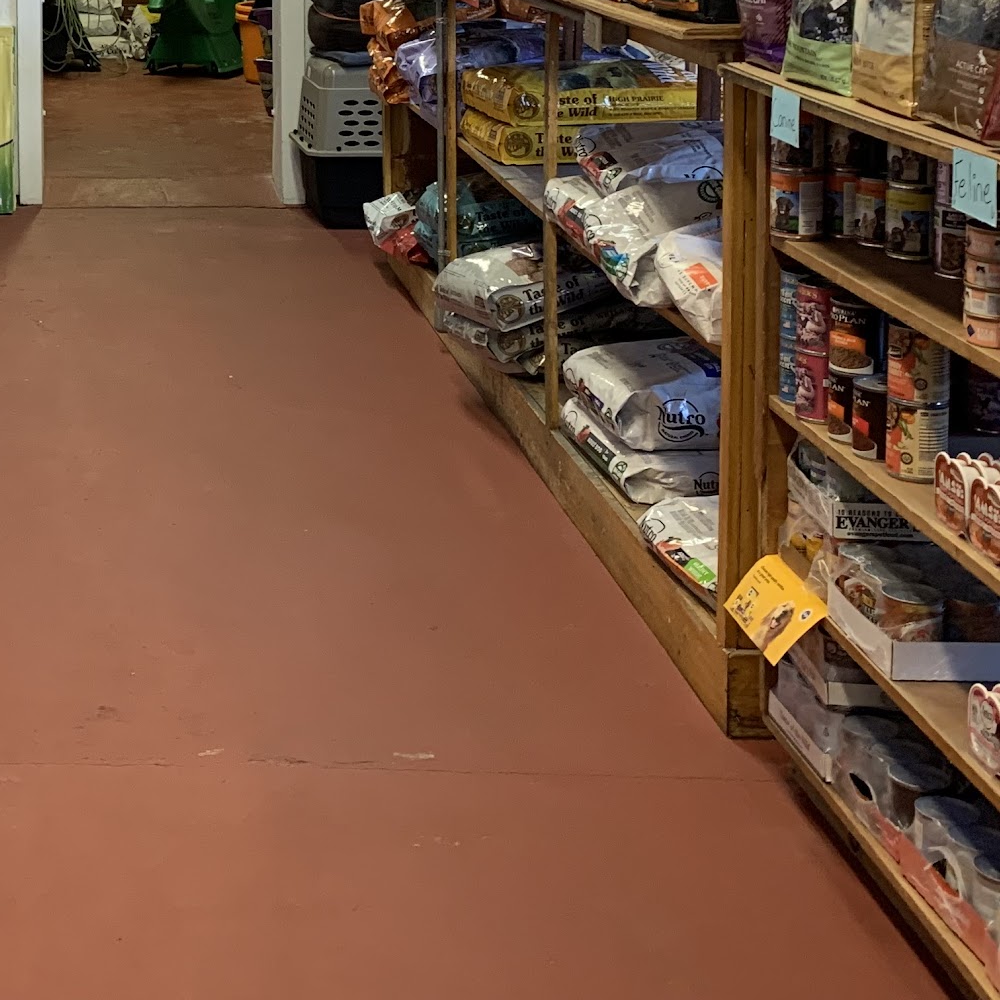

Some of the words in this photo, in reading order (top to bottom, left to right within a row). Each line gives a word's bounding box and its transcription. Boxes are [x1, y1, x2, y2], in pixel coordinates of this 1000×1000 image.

[583, 93, 598, 105] of
[631, 94, 665, 102] PRAIRIE
[568, 106, 598, 118] Wild
[772, 113, 797, 133] Canine
[953, 158, 993, 206] Feline
[565, 275, 581, 289] of
[838, 313, 867, 326] PLAN
[657, 404, 706, 426] Nutro
[692, 478, 719, 491] Nut
[835, 515, 919, 533] EVANGER
